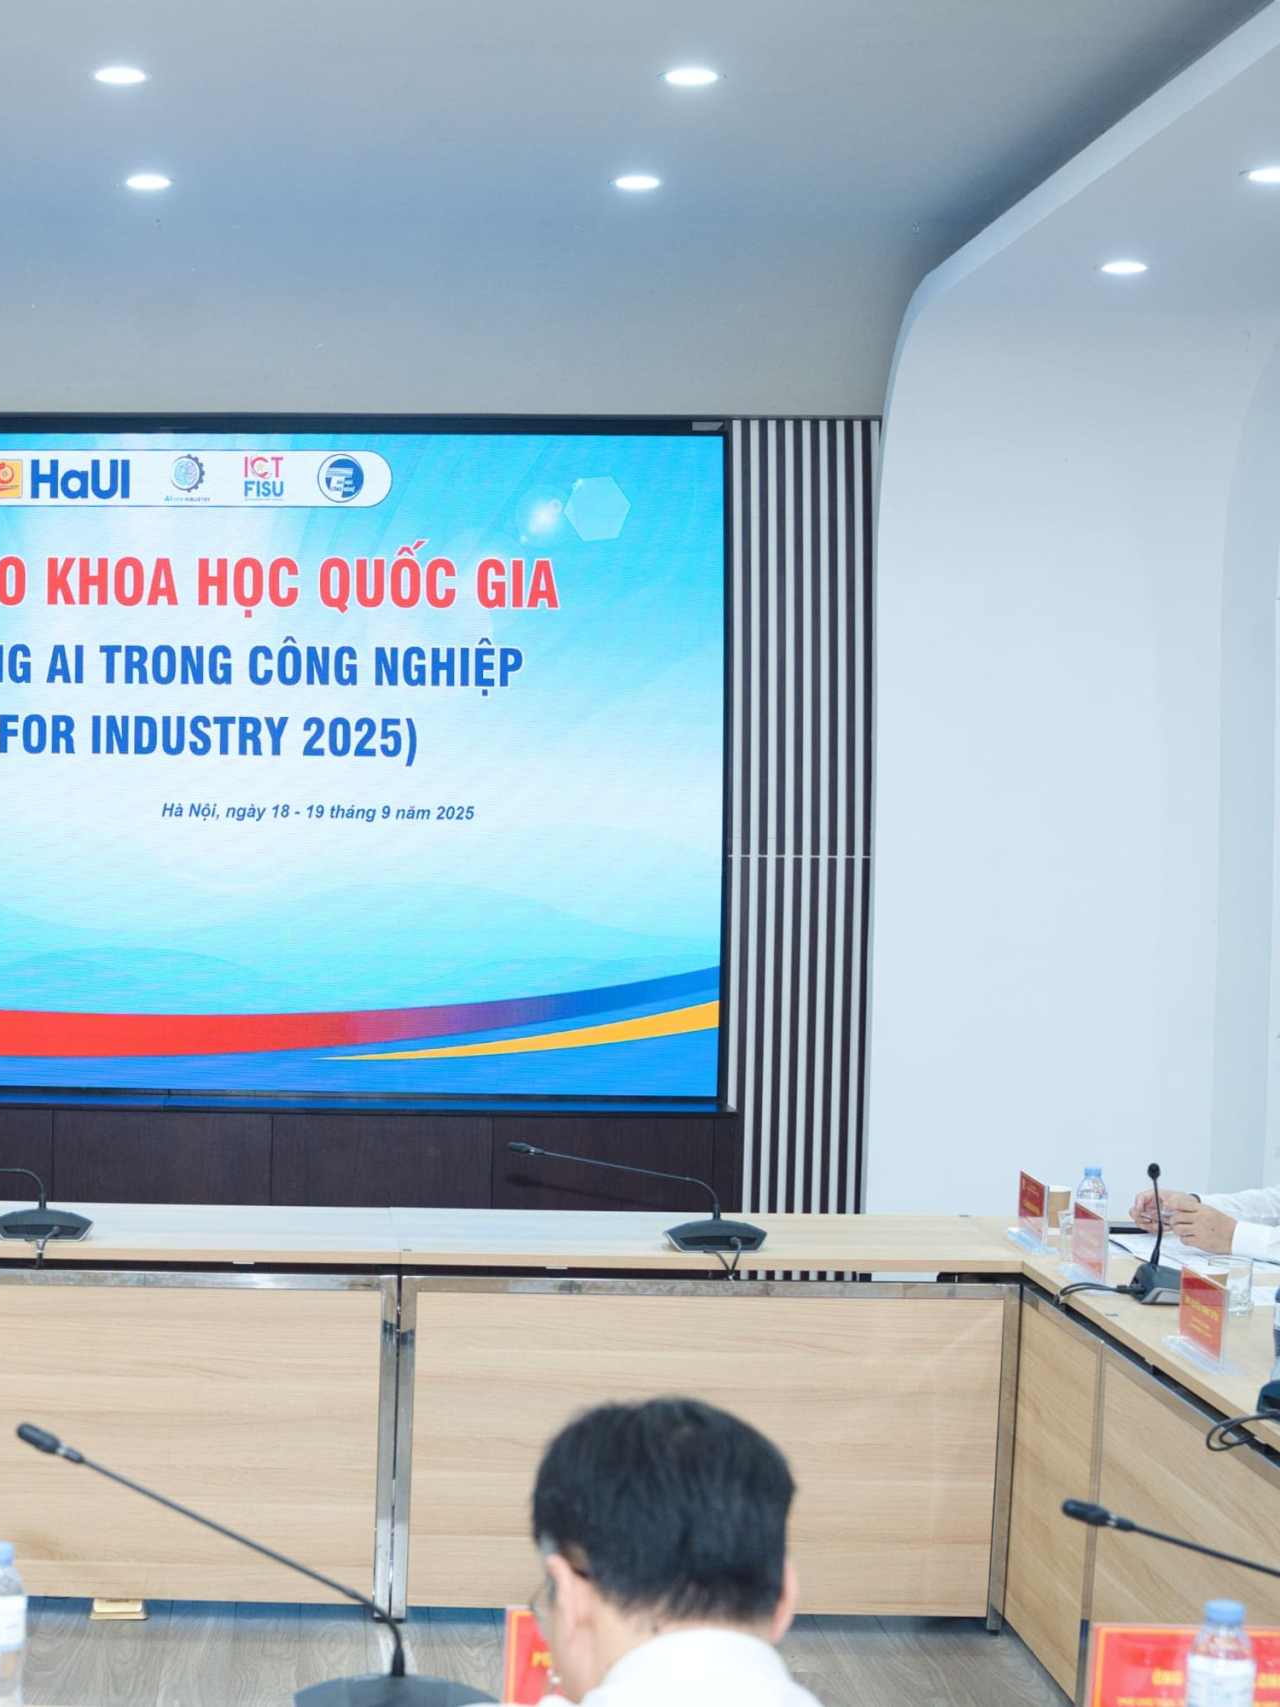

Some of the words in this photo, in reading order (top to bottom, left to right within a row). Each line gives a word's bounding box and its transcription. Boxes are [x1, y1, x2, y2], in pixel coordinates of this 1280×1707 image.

[31, 459, 130, 499] HaUI
[243, 455, 284, 479] ICT
[243, 481, 284, 497] FISU
[47, 557, 178, 607] KHOA
[198, 557, 299, 618] HỌC
[319, 541, 456, 613] QUỐC
[477, 558, 559, 609] GIA
[46, 644, 84, 684] AI
[99, 644, 232, 685] TRONG
[248, 636, 358, 686] CÔNG
[375, 637, 523, 697] NGHIỆP
[91, 715, 289, 756] INDUSTRY
[302, 716, 417, 766] 2025)
[161, 803, 184, 818] Hà
[188, 803, 220, 822] Nội,
[225, 804, 267, 822] ngày
[272, 804, 290, 818] 18
[306, 804, 325, 819] 19
[329, 804, 377, 823] tháng
[381, 805, 391, 819] 9
[395, 806, 431, 820] năm
[436, 805, 475, 820] 2025
